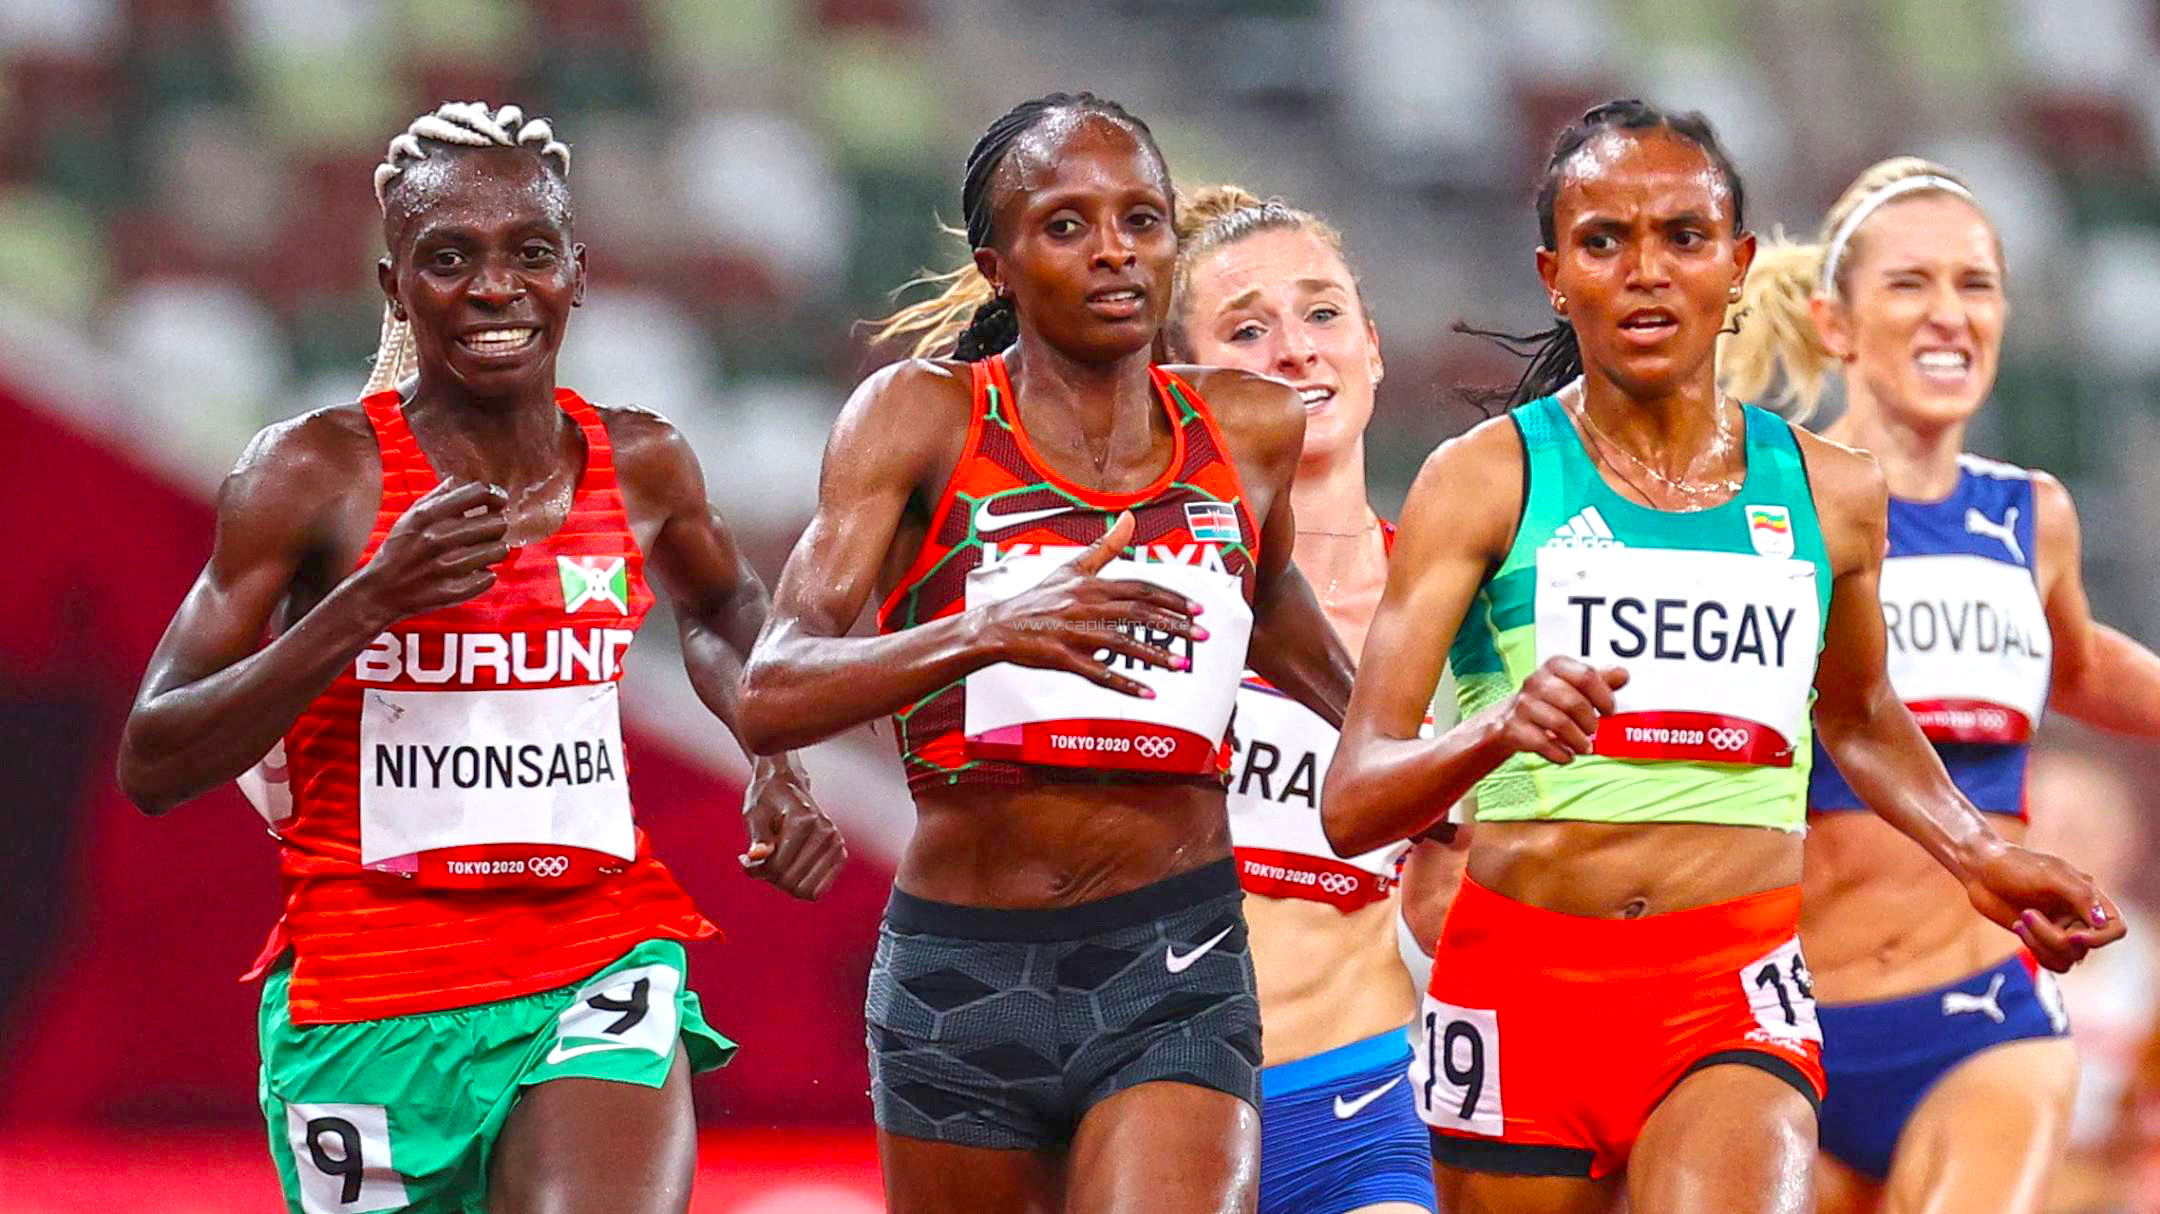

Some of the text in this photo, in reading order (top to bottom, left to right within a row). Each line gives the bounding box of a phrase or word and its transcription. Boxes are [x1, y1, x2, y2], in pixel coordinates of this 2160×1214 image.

[1568, 596, 1796, 667] TSEGAY
[1050, 734, 1130, 752] TOKYO 2020
[1625, 727, 1704, 745] TOKYO 2020
[375, 739, 616, 788] NIYONSABA
[447, 860, 525, 875] TOKYO 2020
[1243, 860, 1317, 885] TOKYO 2020
[1424, 1011, 1485, 1120] 19
[306, 1117, 363, 1204] 9
